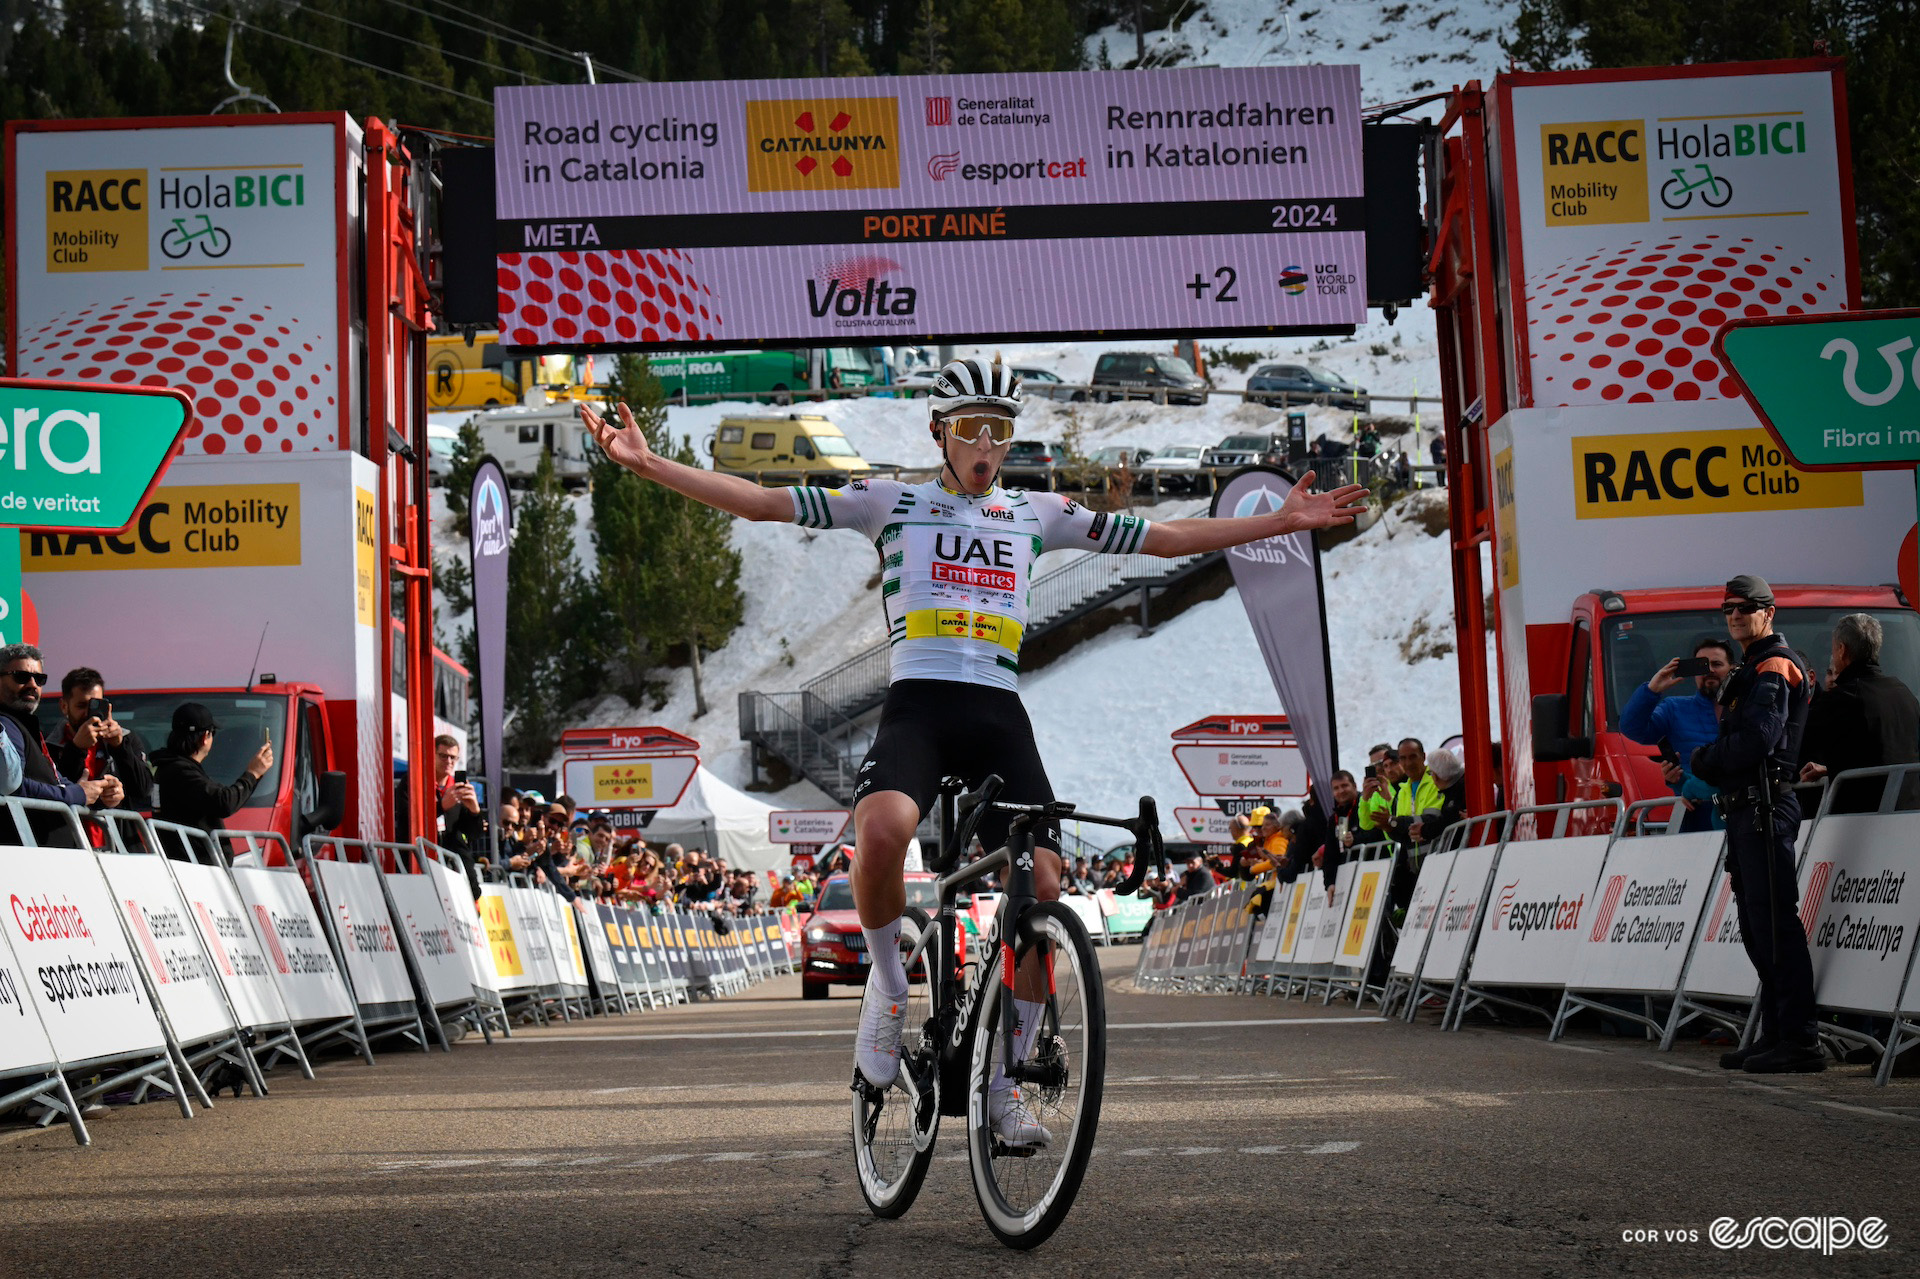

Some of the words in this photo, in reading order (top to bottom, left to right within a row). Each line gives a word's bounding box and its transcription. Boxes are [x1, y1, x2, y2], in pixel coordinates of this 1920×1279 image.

[958, 97, 1034, 110] Generalitat
[1107, 102, 1335, 130] Rennradfahren
[525, 120, 599, 145] Road
[610, 117, 718, 149] cycling
[958, 114, 975, 125] de
[980, 113, 1050, 127] Catalunya
[760, 135, 886, 153] CATALUNYA
[1107, 144, 1134, 168] in
[1145, 140, 1308, 168] Katalonien
[1548, 129, 1639, 166] RACC
[1658, 121, 1806, 160] HolaBICI
[525, 159, 550, 183] in
[560, 155, 704, 182] Catalonia
[961, 157, 1087, 185] esportcat
[52, 178, 141, 213] RACC
[160, 174, 304, 209] HolaBICI
[1551, 181, 1618, 202] Mobility
[1272, 204, 1337, 228] 2024
[1551, 199, 1587, 217] Club
[524, 223, 601, 247] META
[864, 215, 937, 238] PORT
[941, 207, 1006, 237] AINÉ
[53, 229, 119, 248] Mobility
[53, 247, 88, 263] Club
[1315, 265, 1337, 274] UCI
[1315, 274, 1356, 285] WORLD
[806, 278, 917, 318] Volta
[1186, 266, 1238, 302] +2
[1317, 285, 1347, 295] TOUR
[688, 361, 725, 375] RGA
[0, 407, 101, 475] ra
[1823, 428, 1880, 448] Fibra
[1887, 426, 1892, 444] i
[1584, 446, 1729, 504] RACC
[1743, 470, 1800, 495] Club
[1, 491, 27, 510] de
[32, 493, 100, 513] veritat
[184, 500, 288, 528] Mobility
[981, 508, 1015, 520] Volta
[481, 515, 496, 535] port
[881, 528, 902, 546] Volta
[184, 528, 239, 552] Club
[936, 533, 1014, 568] UAE
[935, 565, 1014, 589] Emirates
[1230, 719, 1260, 735] iryo
[611, 733, 641, 750] iryo
[598, 777, 648, 786] CATALUNYA
[1232, 777, 1282, 789] esportcat
[794, 826, 833, 835] Catalunya
[1624, 878, 1688, 907] Generalitat
[1831, 869, 1906, 904] Generalitat
[10, 894, 95, 946] Catalonia,
[143, 906, 186, 940] Generalitat
[272, 911, 315, 939] Generalitat
[1508, 892, 1584, 941] esportcat
[1718, 914, 1732, 943] de
[353, 918, 396, 962] esportcat
[1611, 916, 1625, 943] de
[1627, 915, 1685, 950] Catalunya
[1817, 914, 1835, 948] de
[1836, 914, 1904, 961] Catalunya
[171, 949, 209, 985] Catalunya
[296, 946, 334, 980] Catalunya
[38, 955, 92, 1013] sports
[87, 953, 139, 1004] country
[952, 916, 999, 1048] COLNAGO
